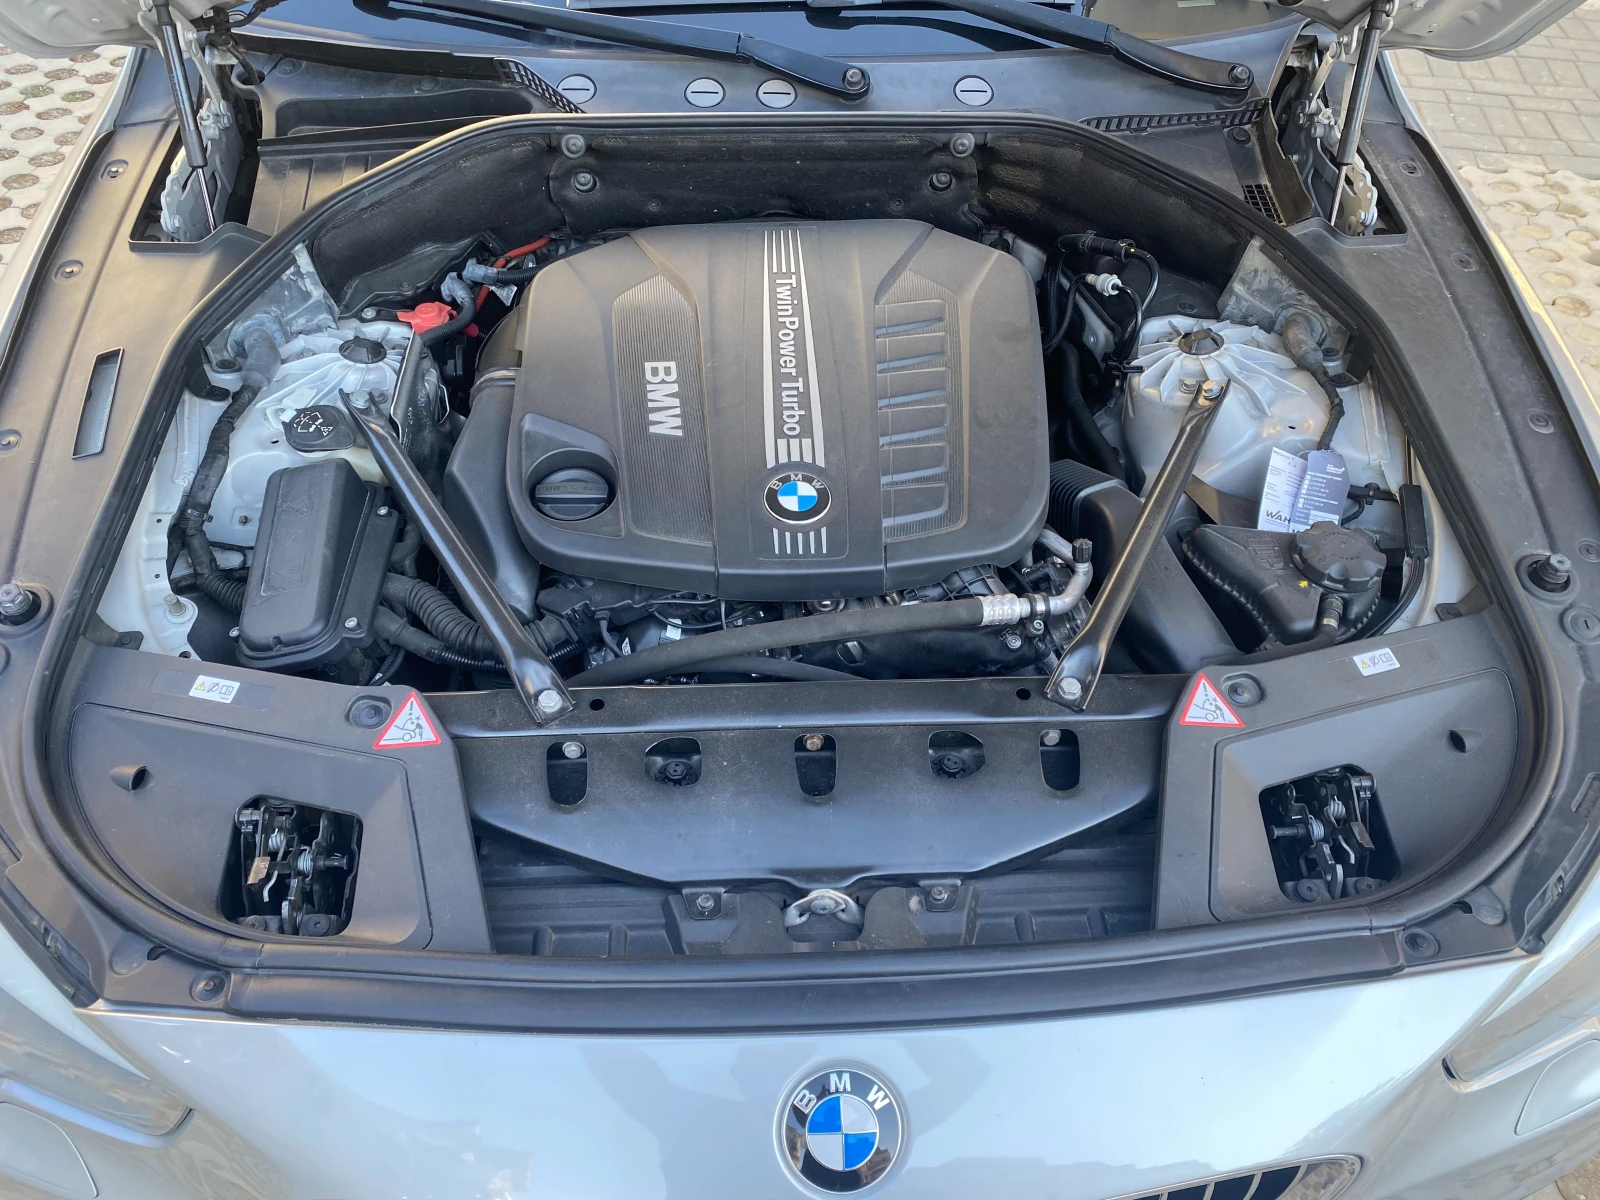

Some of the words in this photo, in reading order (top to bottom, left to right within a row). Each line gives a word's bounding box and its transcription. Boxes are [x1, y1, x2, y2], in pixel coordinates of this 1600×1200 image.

[775, 274, 799, 376] TwinPower
[644, 361, 683, 436] BMW
[781, 377, 806, 436] Turbo
[770, 473, 825, 491] BMW
[793, 1072, 891, 1115] BMW
